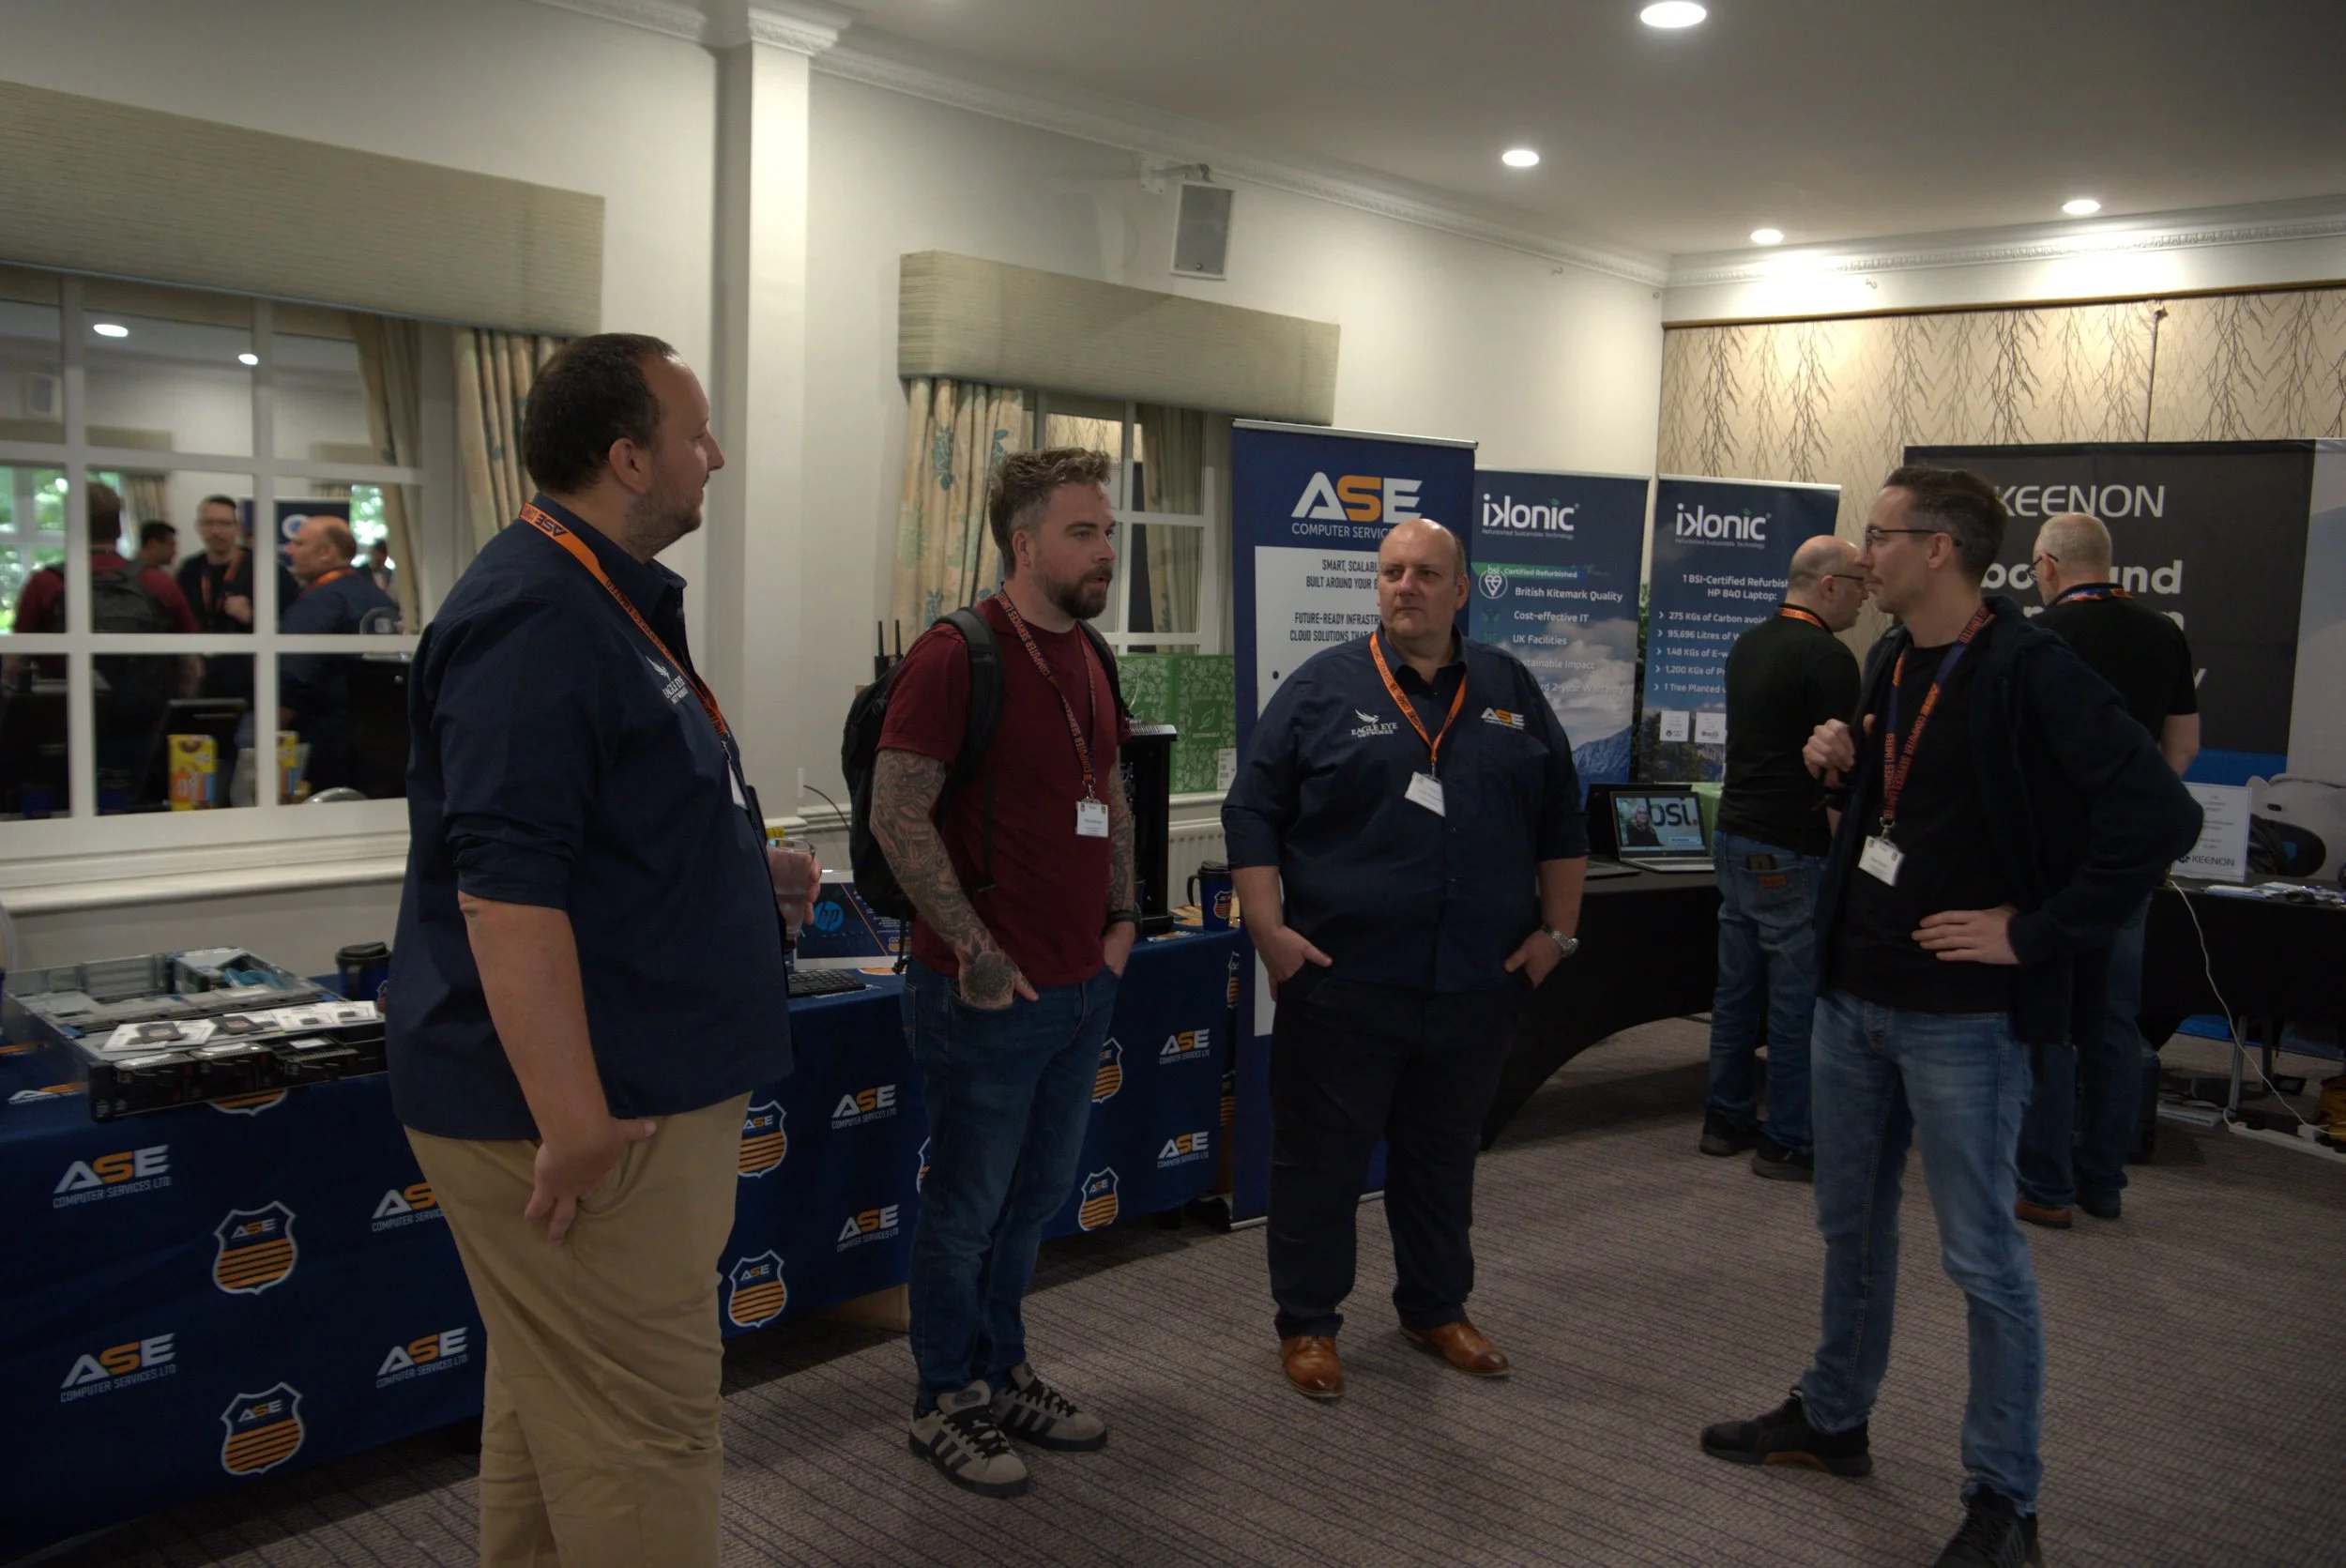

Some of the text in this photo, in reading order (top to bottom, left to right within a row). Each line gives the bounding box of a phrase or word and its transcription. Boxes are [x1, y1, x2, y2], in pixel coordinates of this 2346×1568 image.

[1290, 471, 1423, 524] ASE
[535, 513, 568, 537] ASE
[1291, 523, 1389, 539] COMPUTER SERVIC
[1322, 559, 1378, 573] SMART, SCALABL
[1504, 568, 1577, 579] Certified Refurbished
[1306, 577, 1324, 587] BUILT
[1326, 577, 1352, 588] AROUND
[1354, 578, 1372, 589] YOUR
[1688, 574, 1744, 586] BSI-Certified
[1747, 577, 1789, 587] Refurbis
[1515, 586, 1623, 603] British Kitemark Quality
[1707, 588, 1777, 602] HP 840 Laptop:
[1008, 610, 1031, 641] SERVICES
[1295, 612, 1380, 625] FUTURE-READY INFRASTR
[1514, 610, 1589, 622] Cost-effective IT
[1668, 611, 1766, 624] 275 KGs of Carbon avoid
[1290, 630, 1311, 641] CLOUD
[1313, 631, 1349, 642] SOLUTIONS
[1513, 633, 1568, 646] UK Facilities
[1697, 631, 1720, 640] Litres
[1721, 632, 1730, 640] of
[1026, 640, 1051, 677] COMPUTER
[1683, 648, 1699, 657] KGs
[1700, 648, 1710, 657] of
[1522, 659, 1562, 668] stainable
[1688, 666, 1704, 675] KGs
[1705, 666, 1714, 675] of
[1669, 683, 1686, 693] Tree
[1688, 683, 1720, 693] Planted
[1481, 707, 1525, 727] ASE
[1350, 722, 1398, 736] EAGLE EYE
[2192, 855, 2234, 867] KEENON
[817, 901, 842, 933] hp
[1159, 1028, 1211, 1056] ASE
[831, 1084, 897, 1119] ASE
[1157, 1131, 1210, 1160] ASE
[53, 1144, 171, 1195] ASE
[53, 1189, 105, 1209] COMPUTER
[106, 1179, 151, 1198] SERVICES
[372, 1182, 436, 1220] AS
[231, 1217, 278, 1240] ASE
[372, 1208, 443, 1232] COMPUTER SERVIC
[837, 1203, 900, 1242] ASE
[739, 1263, 770, 1282] ASE
[60, 1332, 176, 1390] ASE
[375, 1326, 468, 1377] ASE
[60, 1362, 177, 1403] COMPUTER SERVICES LTD
[376, 1367, 416, 1389] COMPUTER
[417, 1358, 453, 1376] SERVICES
[237, 1399, 283, 1423] ASE
